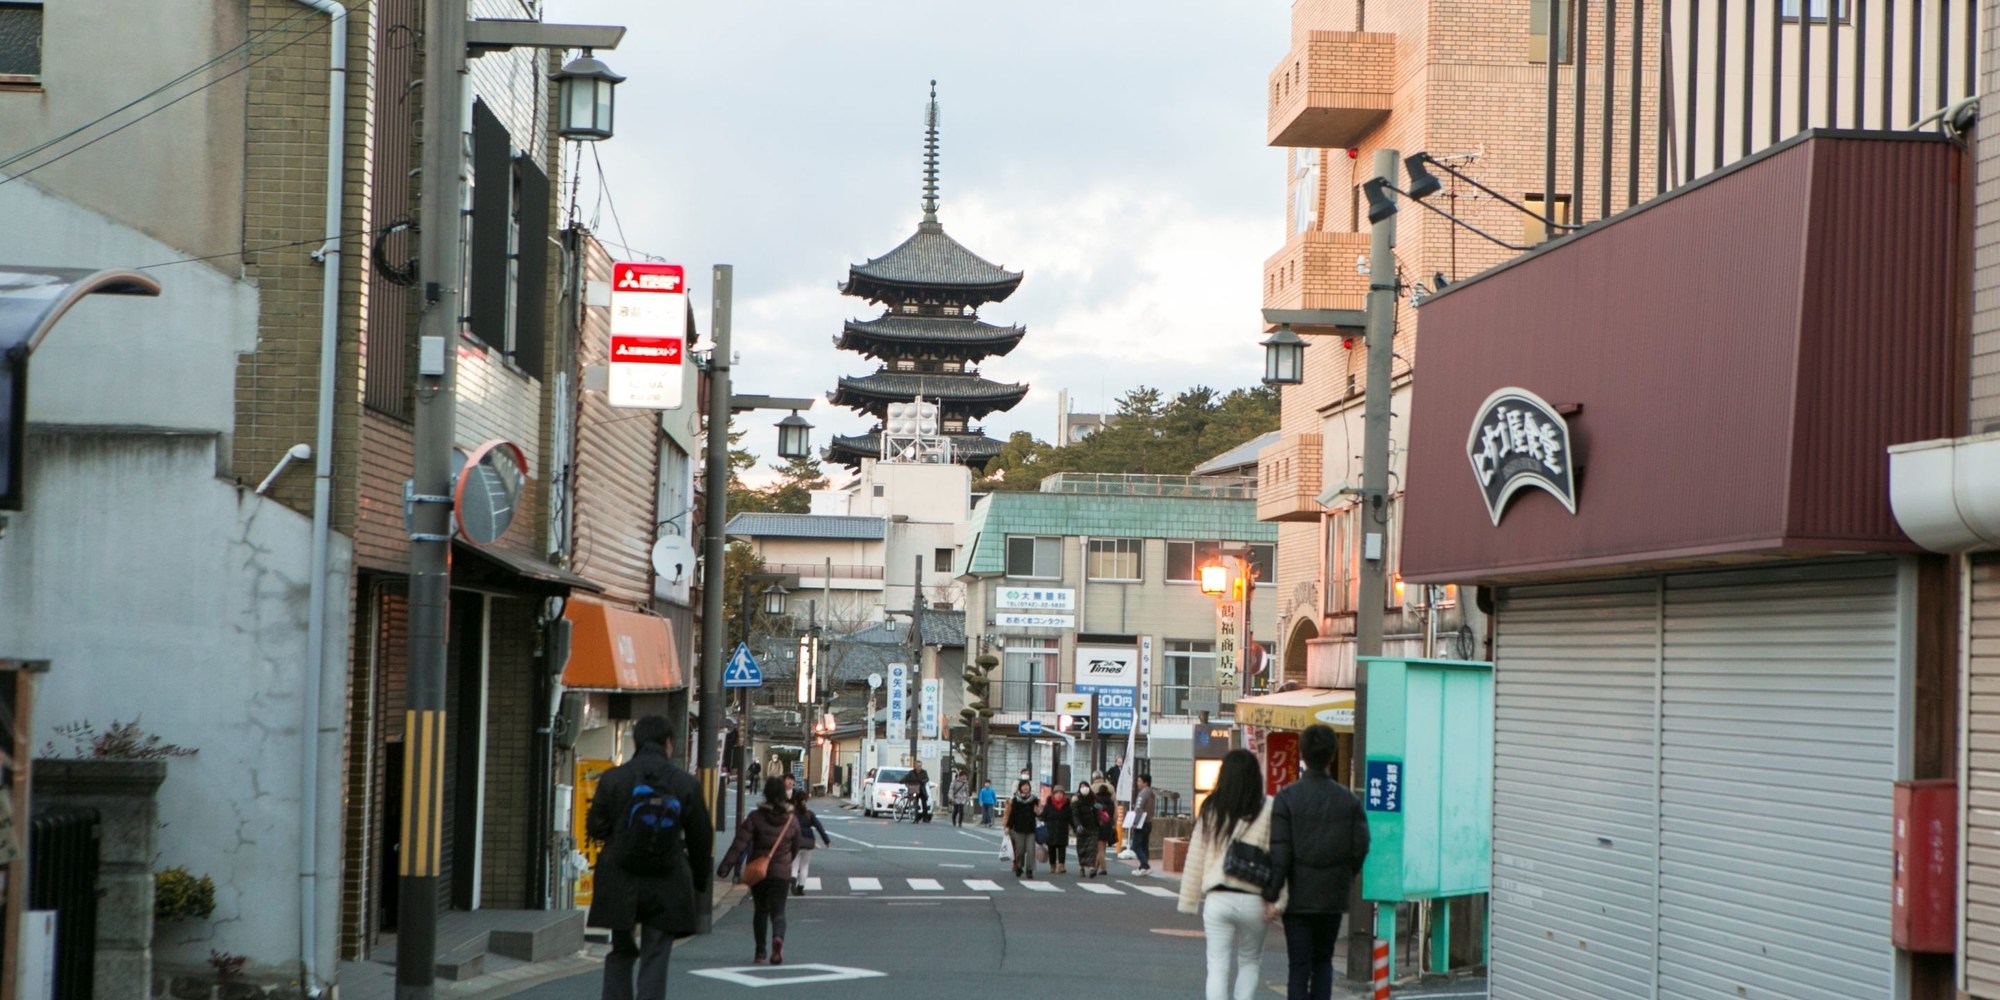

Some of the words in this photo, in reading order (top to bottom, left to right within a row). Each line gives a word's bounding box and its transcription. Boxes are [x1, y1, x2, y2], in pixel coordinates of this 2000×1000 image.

[1022, 592, 1066, 600] 大熊眼科
[1005, 617, 1066, 625] おおくまコンタクト
[1220, 604, 1235, 687] 鶴福商店会
[1088, 660, 1127, 673] Times
[1142, 642, 1150, 726] ならまち駐車場
[1098, 718, 1131, 730] 00円
[1285, 739, 1298, 785] ファッショ
[1370, 777, 1382, 807] 作動中
[1386, 764, 1398, 810] 監視カメラ
